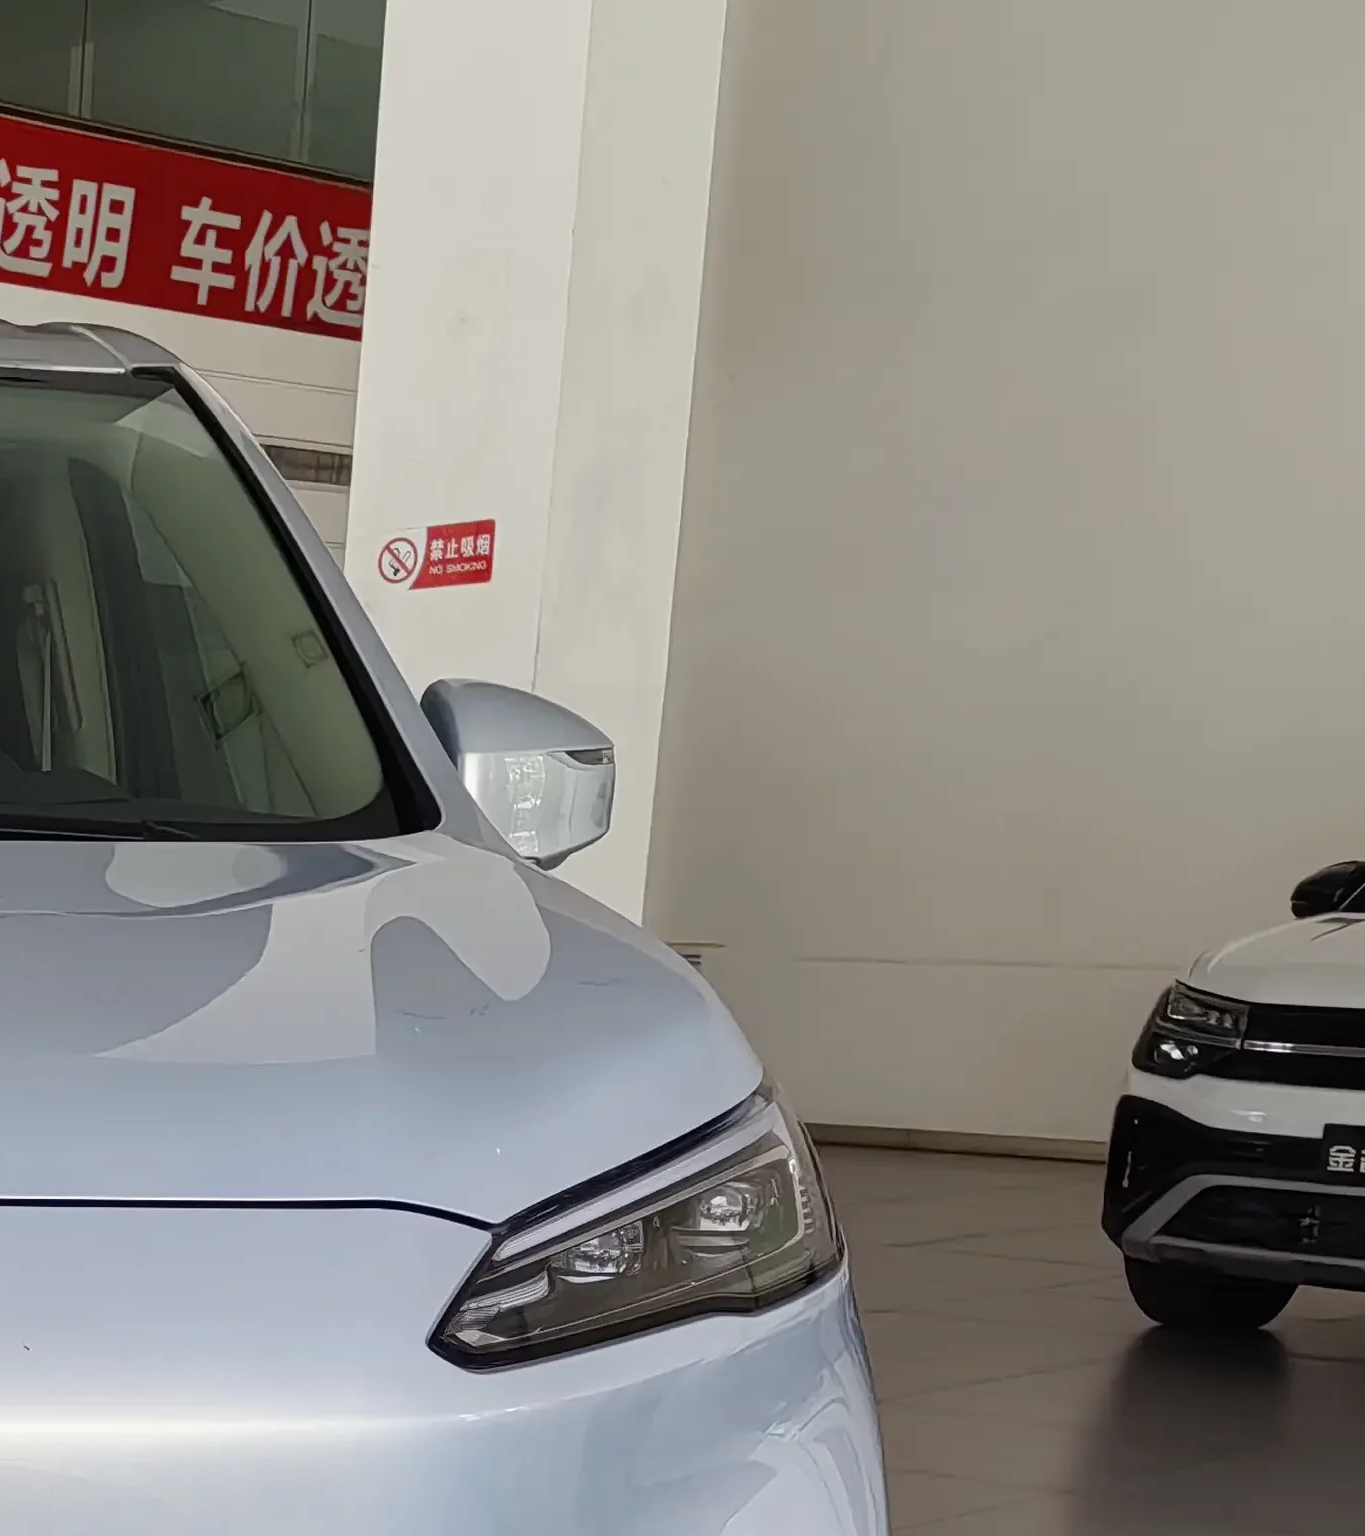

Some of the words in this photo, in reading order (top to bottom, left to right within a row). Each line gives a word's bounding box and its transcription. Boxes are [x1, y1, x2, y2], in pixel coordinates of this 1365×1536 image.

[170, 197, 370, 328] 车价透
[429, 534, 490, 561] 禁止吸烟
[430, 566, 443, 575] NO
[447, 561, 486, 573] SMOKING
[1326, 1145, 1365, 1173] 金
